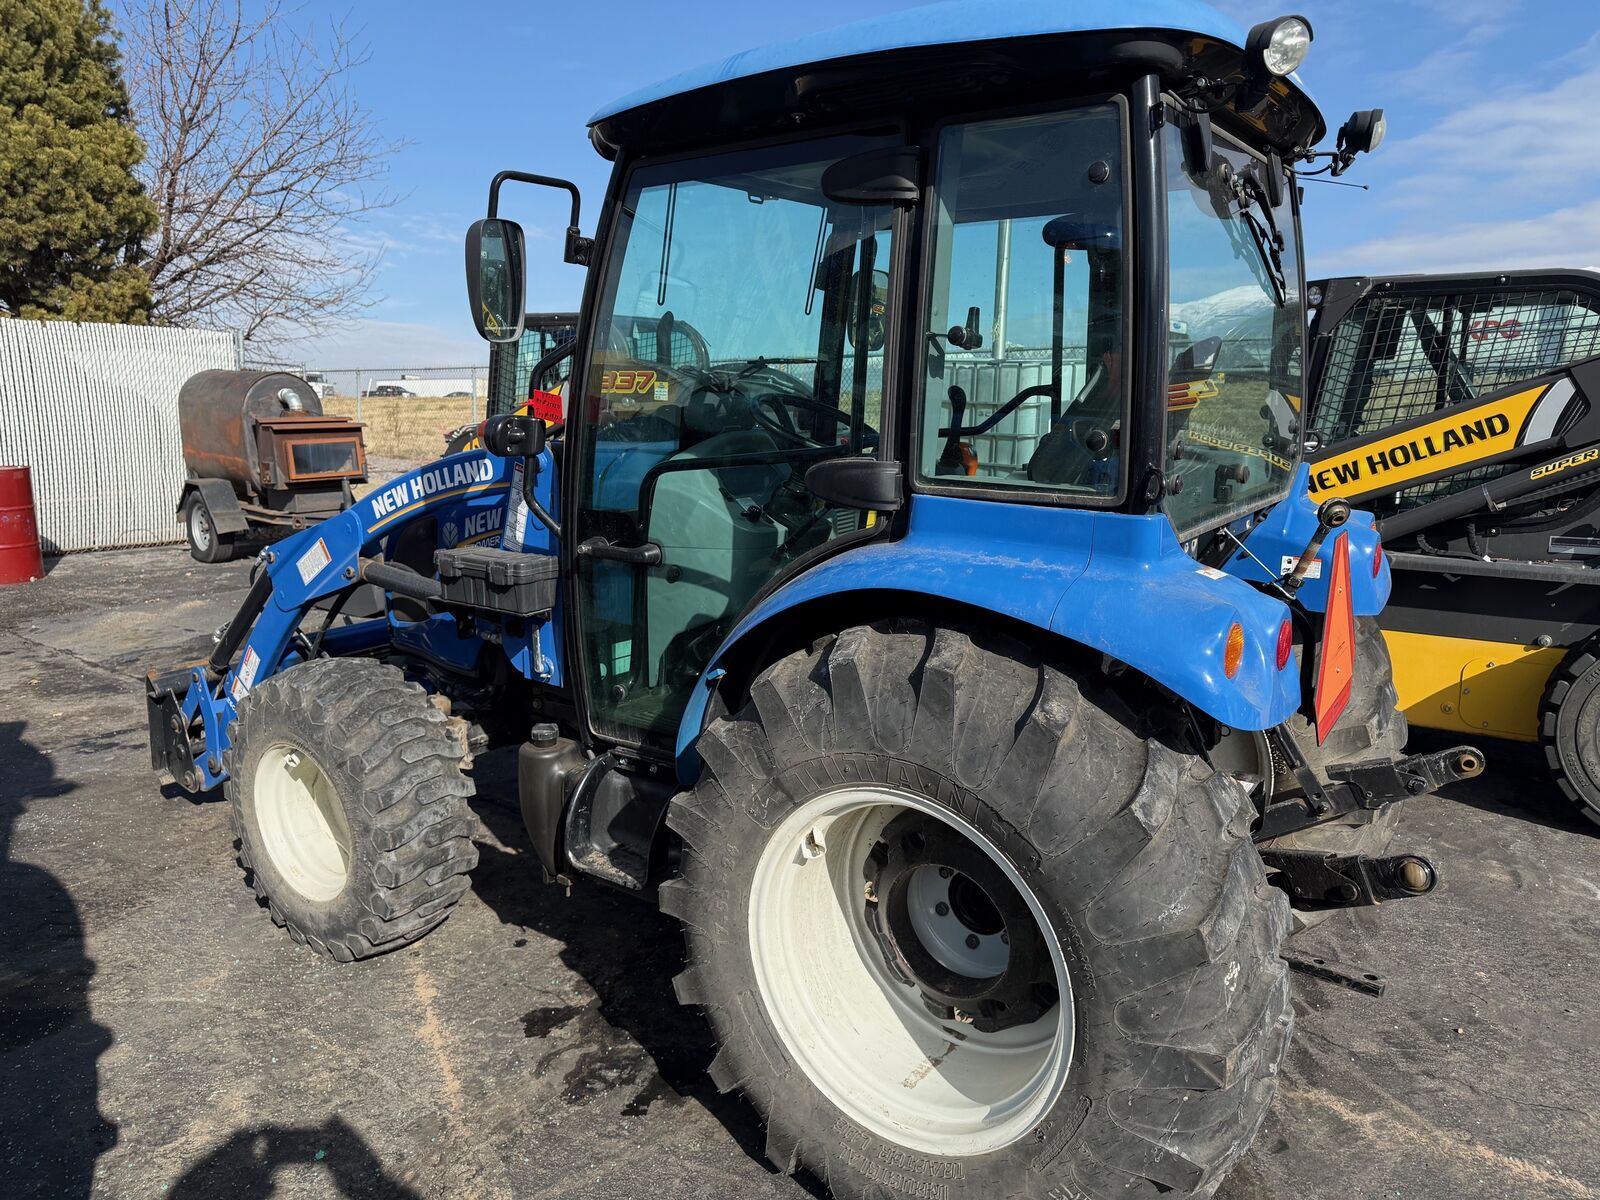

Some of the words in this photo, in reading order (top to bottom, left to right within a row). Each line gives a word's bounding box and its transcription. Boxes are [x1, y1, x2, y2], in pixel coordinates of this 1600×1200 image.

[1366, 412, 1511, 475] HOLLAND
[1530, 448, 1599, 480] SUPER
[370, 489, 410, 520] NEW
[411, 457, 494, 498] HOLLAND
[464, 507, 503, 538] NEW
[786, 754, 981, 822] TITAN
